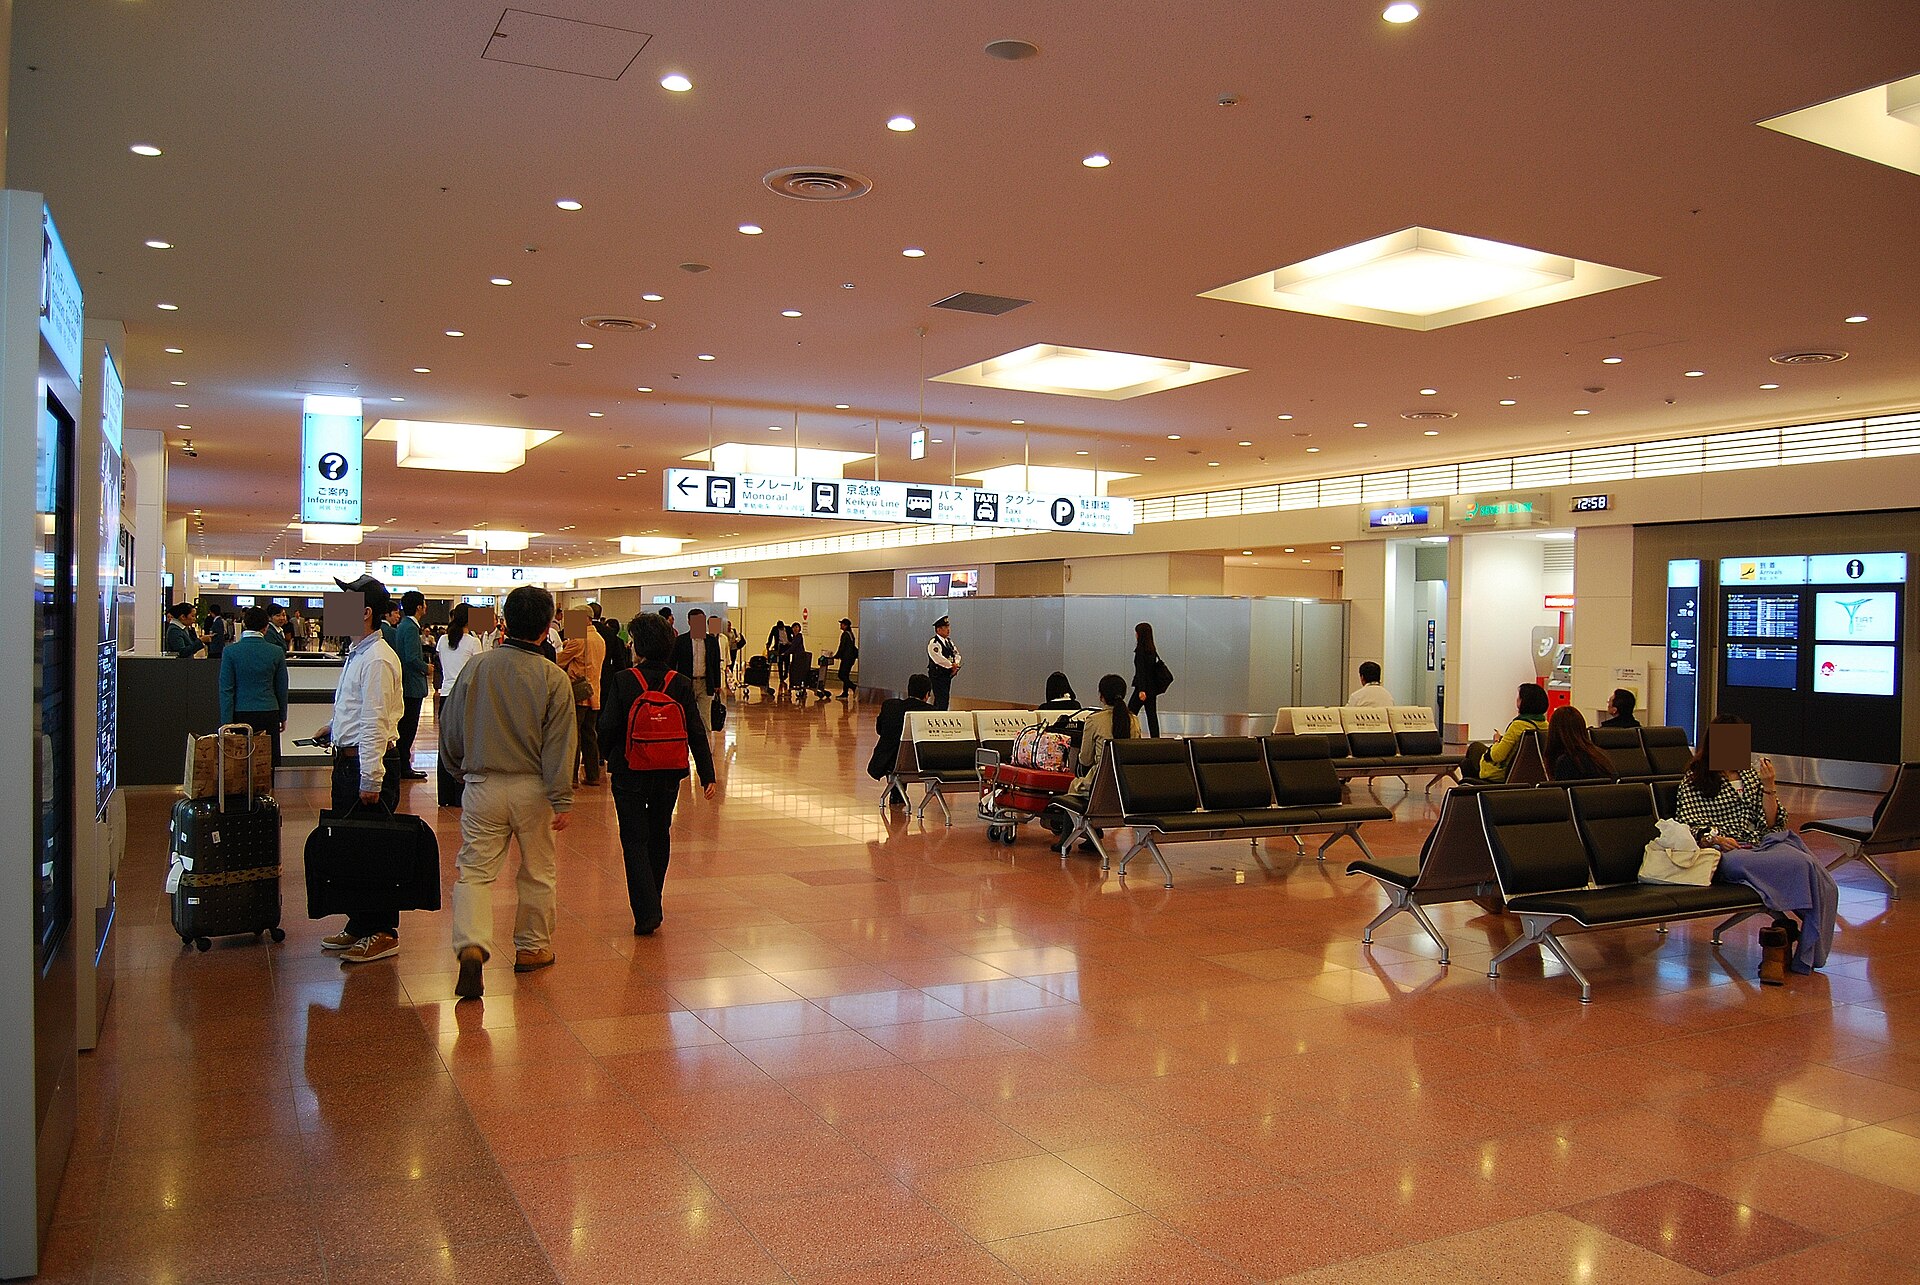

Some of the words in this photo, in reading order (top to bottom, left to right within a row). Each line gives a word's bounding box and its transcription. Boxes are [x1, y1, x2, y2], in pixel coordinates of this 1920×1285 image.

[743, 478, 804, 491] モノレール
[318, 487, 349, 497] ご案内
[742, 491, 788, 501] Monorail
[846, 484, 881, 497] 京急線
[938, 490, 963, 501] バス
[307, 496, 358, 505] Information
[880, 498, 900, 509] Line
[974, 493, 998, 503] TAXI
[1005, 494, 1046, 506] タクシー
[1577, 496, 1606, 510] 12:58
[938, 502, 954, 512] Bus
[1005, 506, 1022, 515] Taxi
[1080, 511, 1111, 522] Parking
